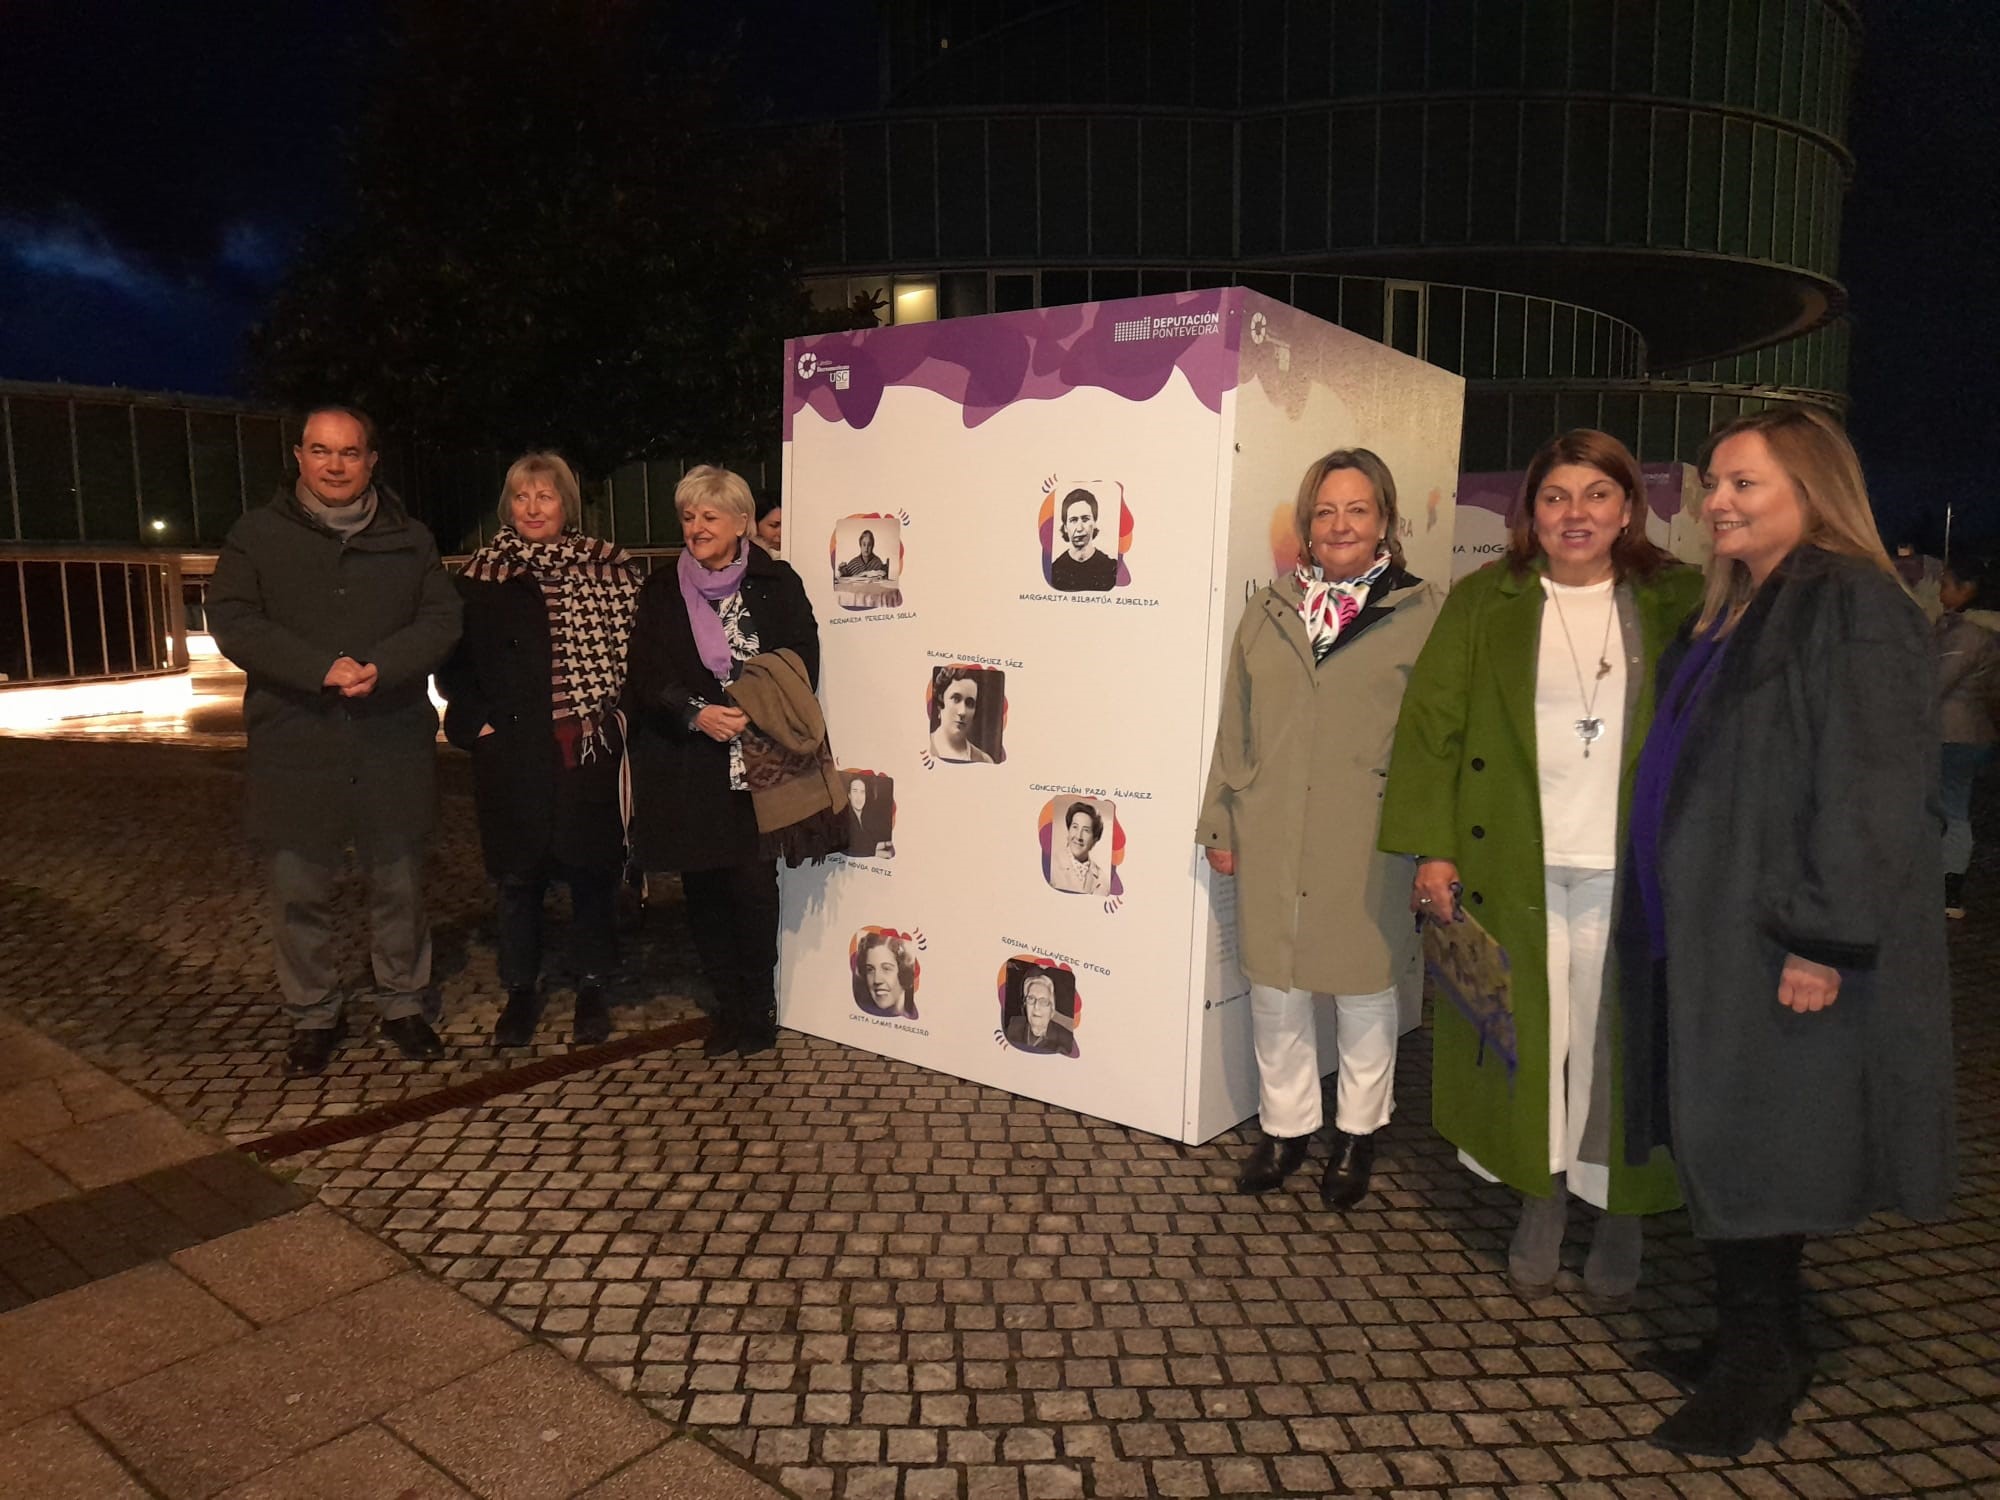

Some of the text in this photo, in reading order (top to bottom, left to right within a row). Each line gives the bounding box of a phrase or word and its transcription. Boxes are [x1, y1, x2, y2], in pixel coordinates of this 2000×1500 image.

[1153, 311, 1219, 328] DEPUTACIÓN
[1152, 324, 1219, 339] PONTEVEDRA
[1019, 594, 1159, 606] MARGARITA BILBATÚA ZUBELDIA
[865, 613, 895, 622] PEREIRA
[897, 611, 918, 620] SOLLA
[927, 650, 1024, 668] BLANCA RODRÍGUEZ SÁEZ
[1029, 784, 1153, 799] CONCEPCIÓN PAZO ÁLVAREZ
[871, 866, 893, 876] ORTIZ
[1001, 936, 1111, 976] ROSINA VILLAVERDE OTERO
[894, 1023, 929, 1036] BARREIRO
